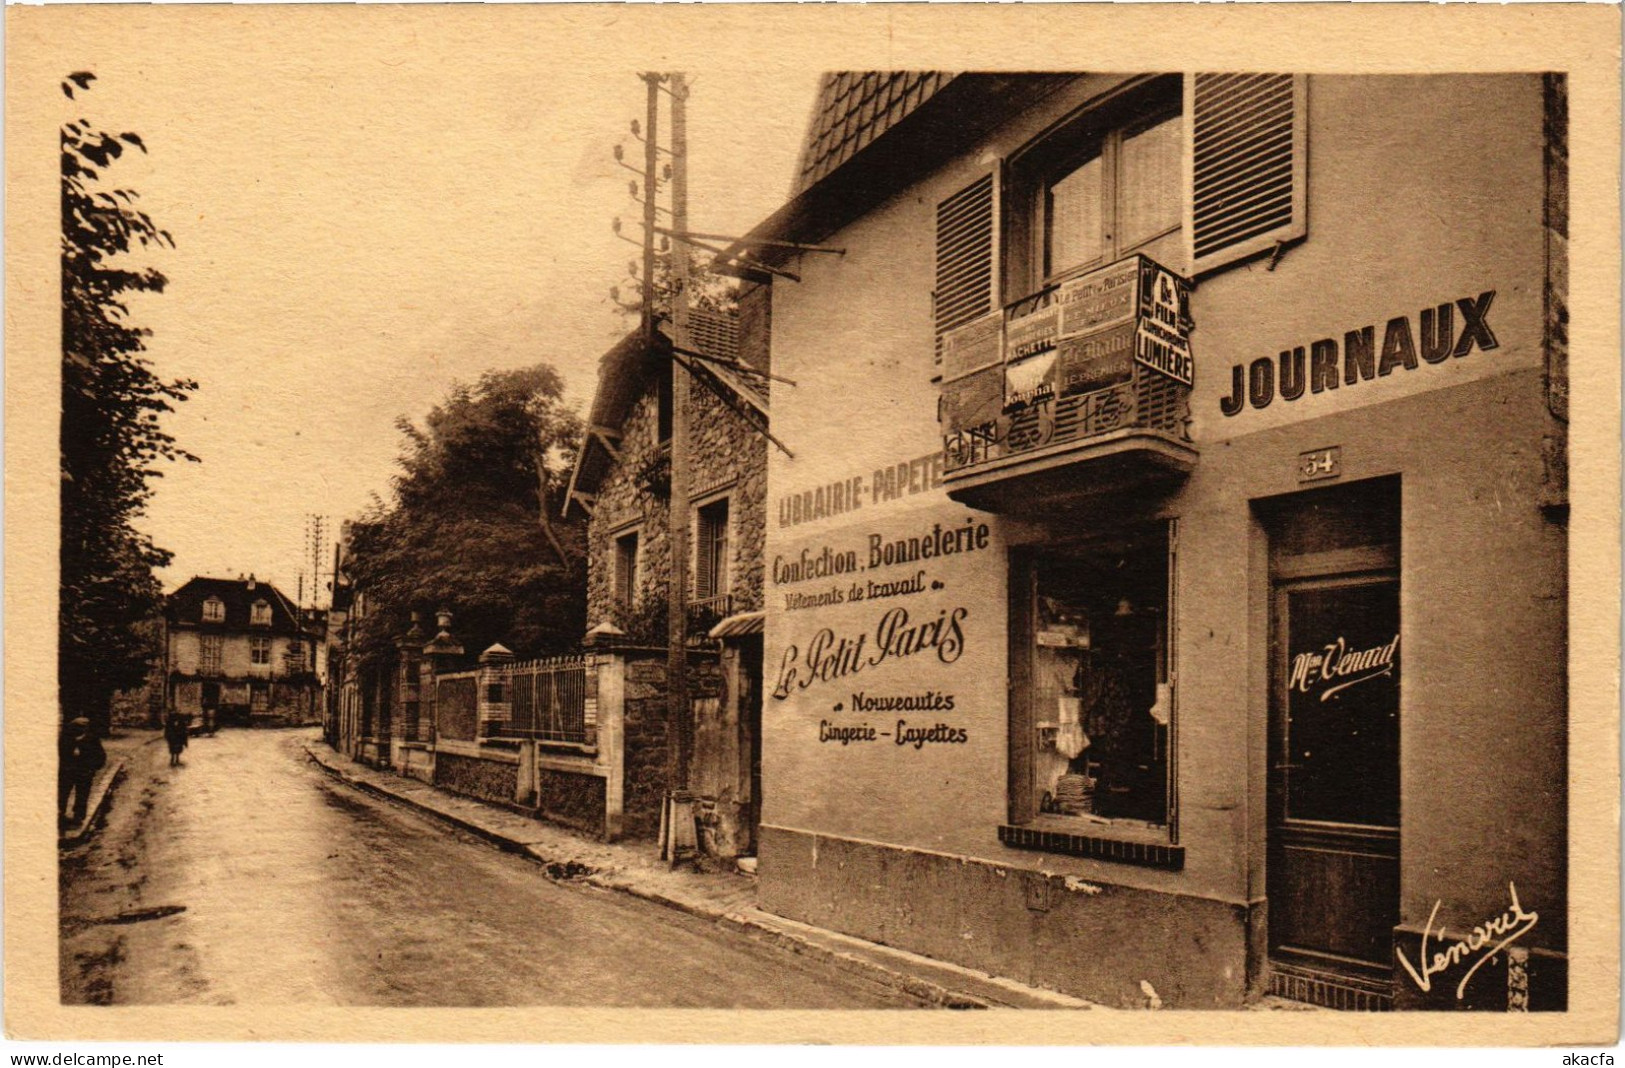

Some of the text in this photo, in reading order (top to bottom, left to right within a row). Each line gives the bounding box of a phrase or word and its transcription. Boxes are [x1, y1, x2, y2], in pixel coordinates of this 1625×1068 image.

[1155, 302, 1176, 328] FILM
[1136, 331, 1191, 382] LUMIÈRE
[1220, 289, 1499, 417] JOURNAUX
[1305, 451, 1334, 476] 54
[868, 517, 989, 569] Bonneterie
[847, 583, 864, 603] de
[866, 570, 926, 599] travail
[772, 607, 968, 700] Le Petit Paris
[852, 691, 955, 711] Nouveautés
